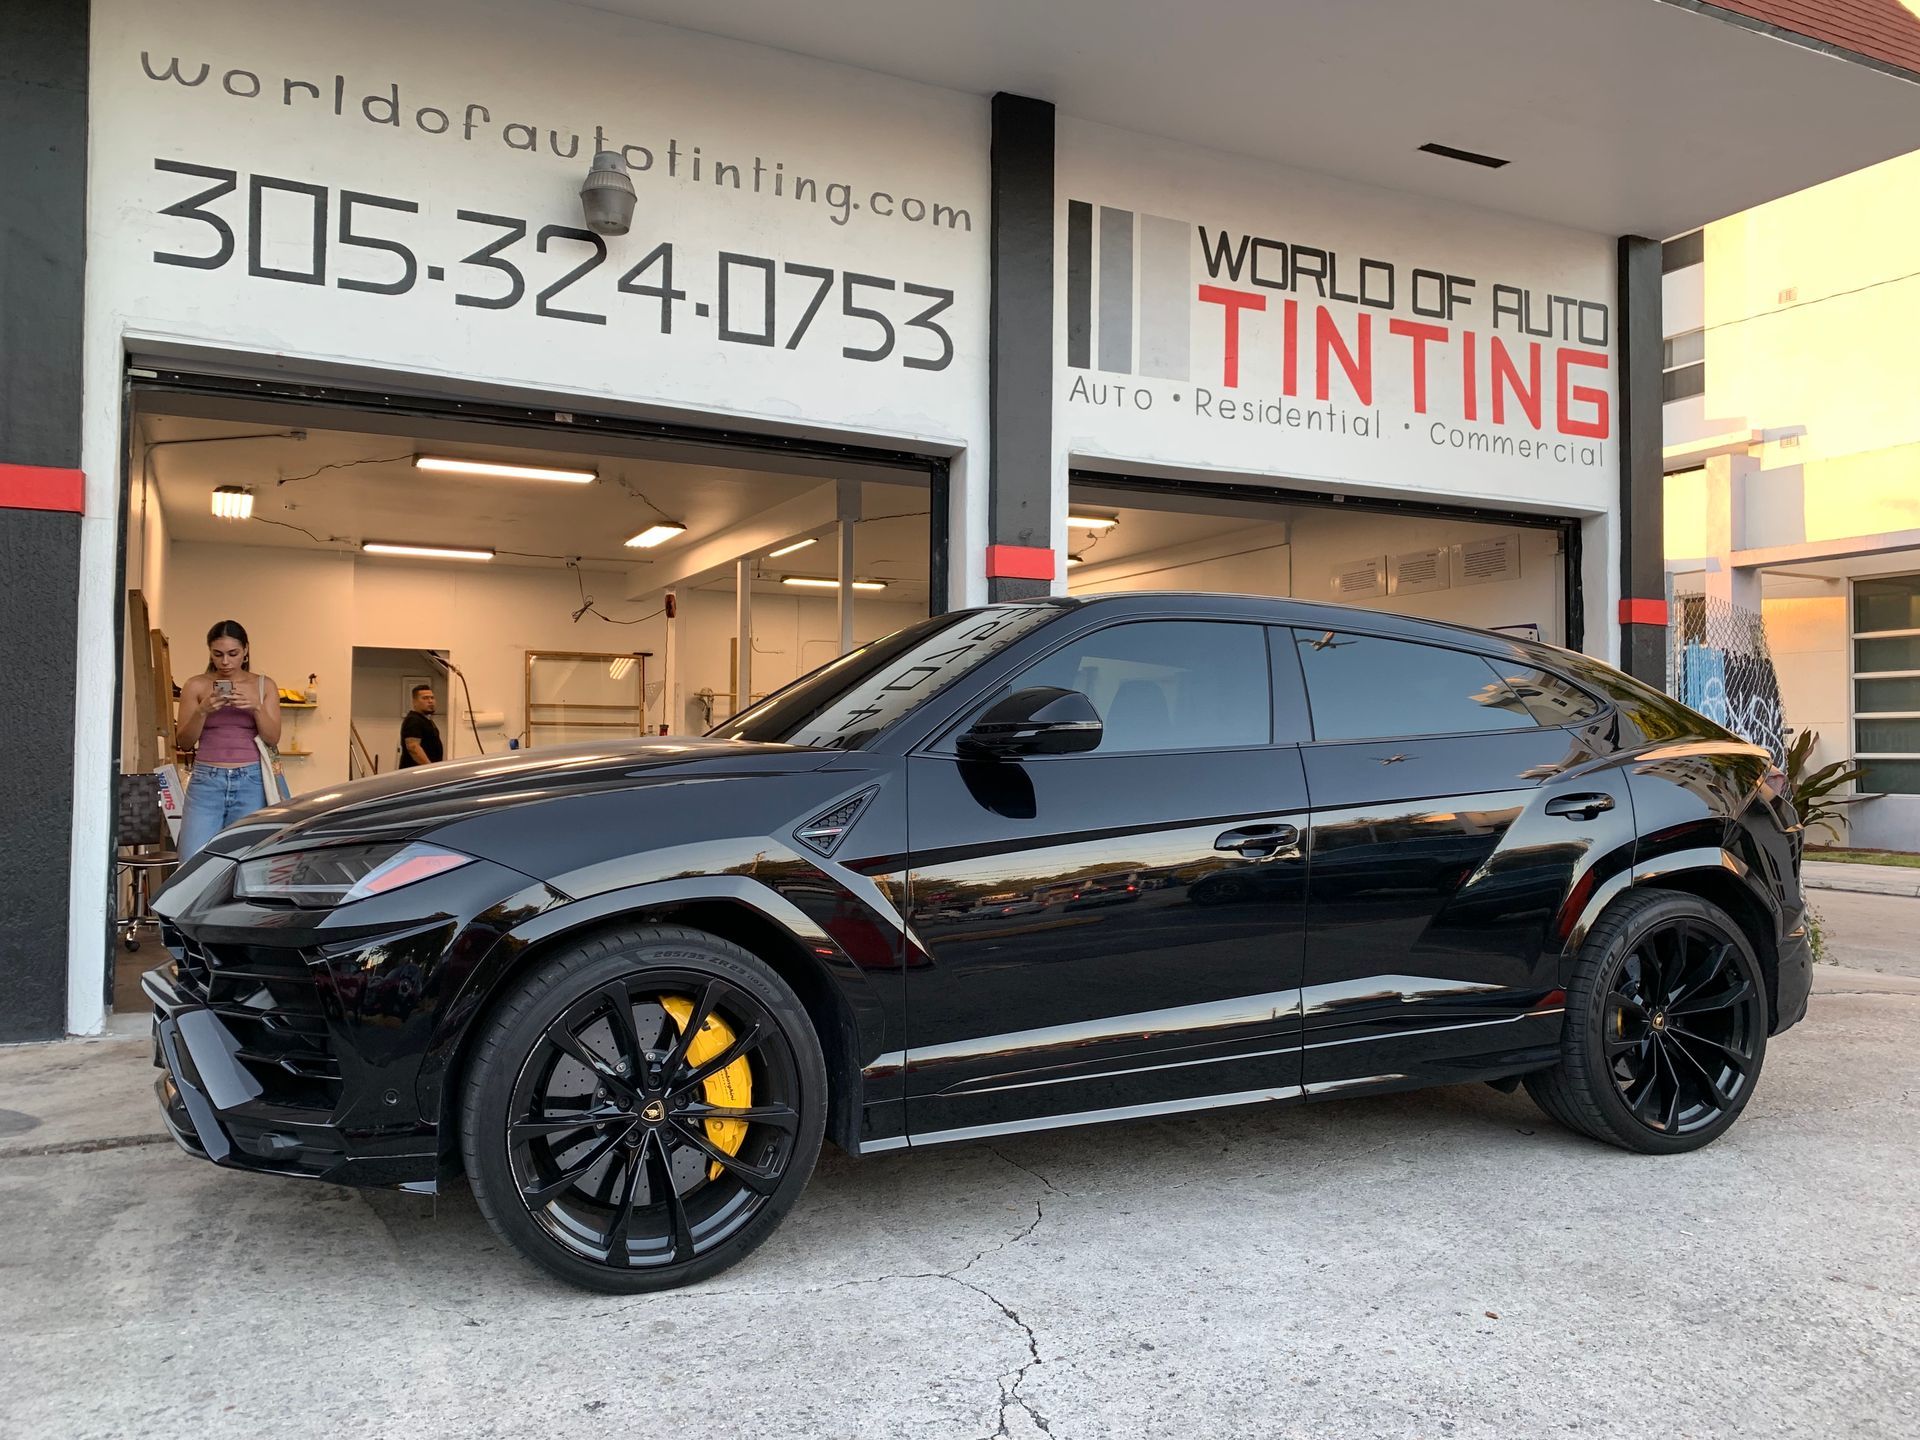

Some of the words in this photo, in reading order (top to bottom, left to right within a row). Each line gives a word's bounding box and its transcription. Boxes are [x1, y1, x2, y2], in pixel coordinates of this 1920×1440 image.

[140, 51, 972, 232] worldofautotinting.com
[154, 158, 954, 372] 305.324.0753
[1198, 225, 1395, 310] WORLD
[1412, 269, 1476, 320] OF
[1493, 284, 1608, 347] AUTO
[1195, 388, 1381, 439] Residential
[1430, 421, 1604, 467] Commercial
[1198, 284, 1609, 439] TINTING
